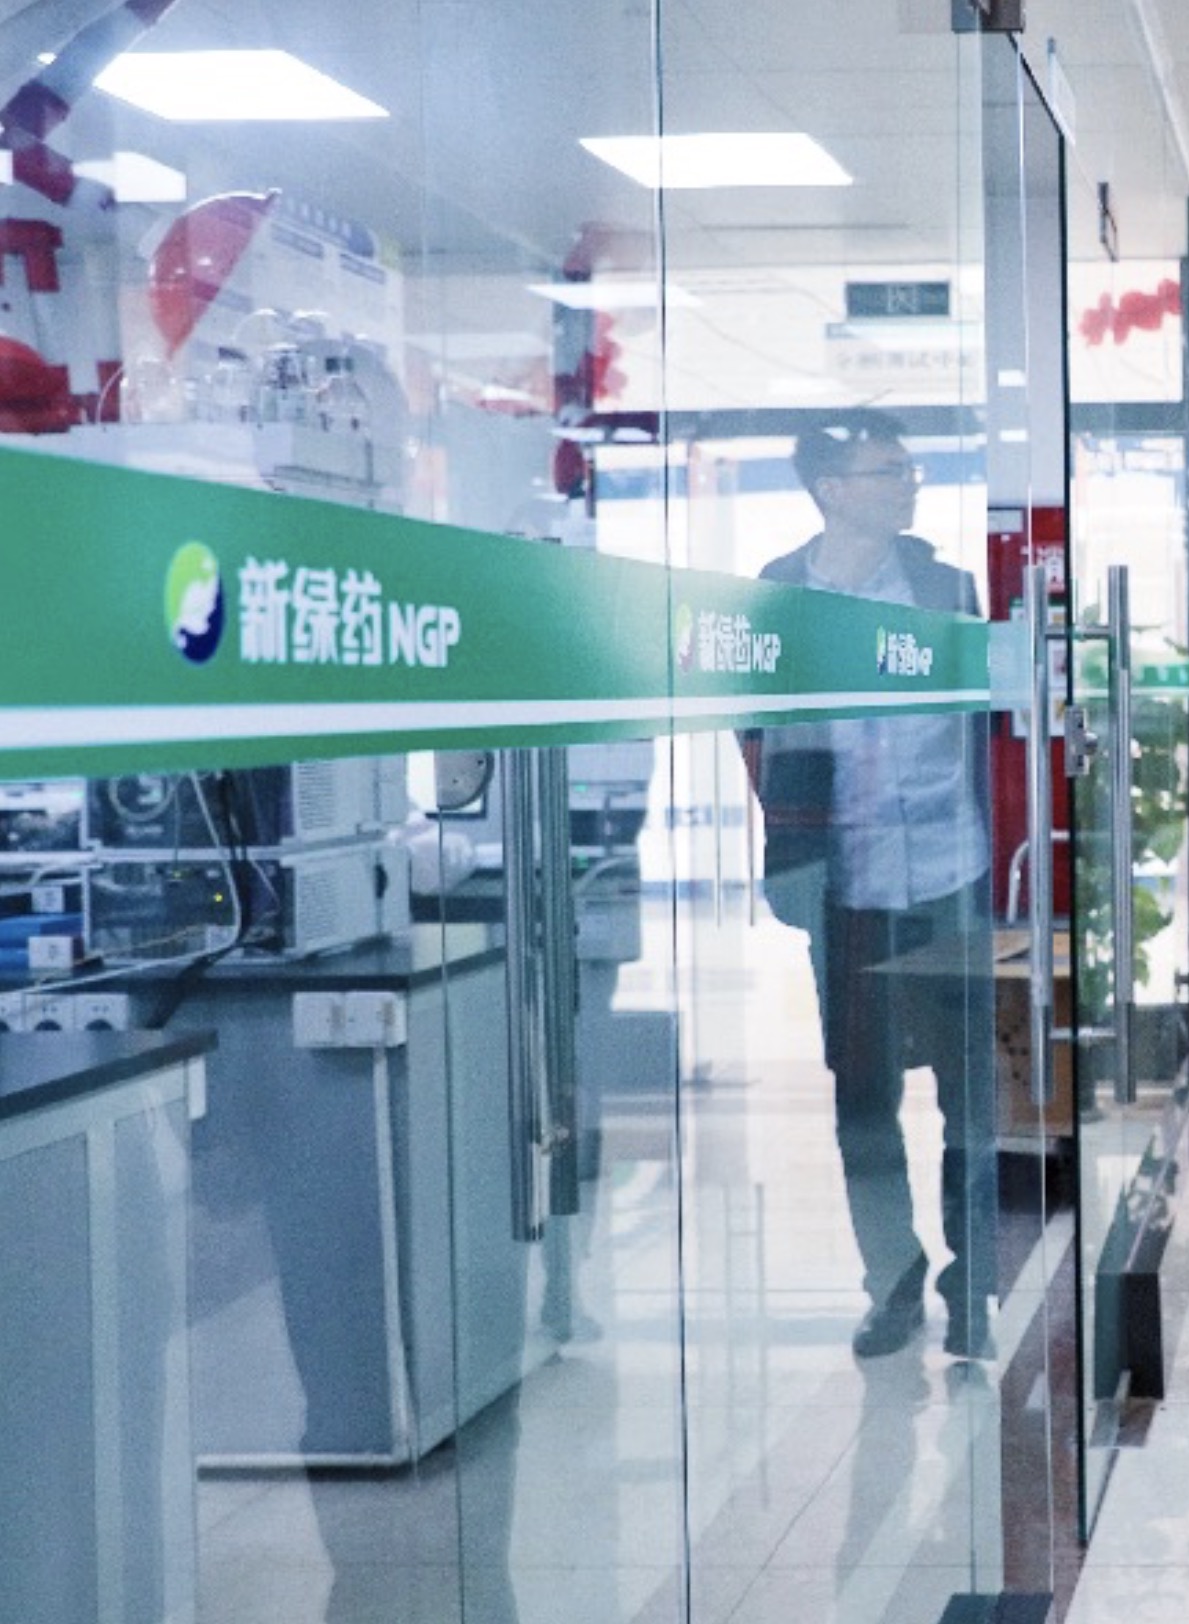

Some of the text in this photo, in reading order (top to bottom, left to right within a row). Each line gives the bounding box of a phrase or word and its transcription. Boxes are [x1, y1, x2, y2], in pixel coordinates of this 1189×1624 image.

[238, 555, 461, 667] 新绿药 NGP
[753, 633, 781, 673] NGP
